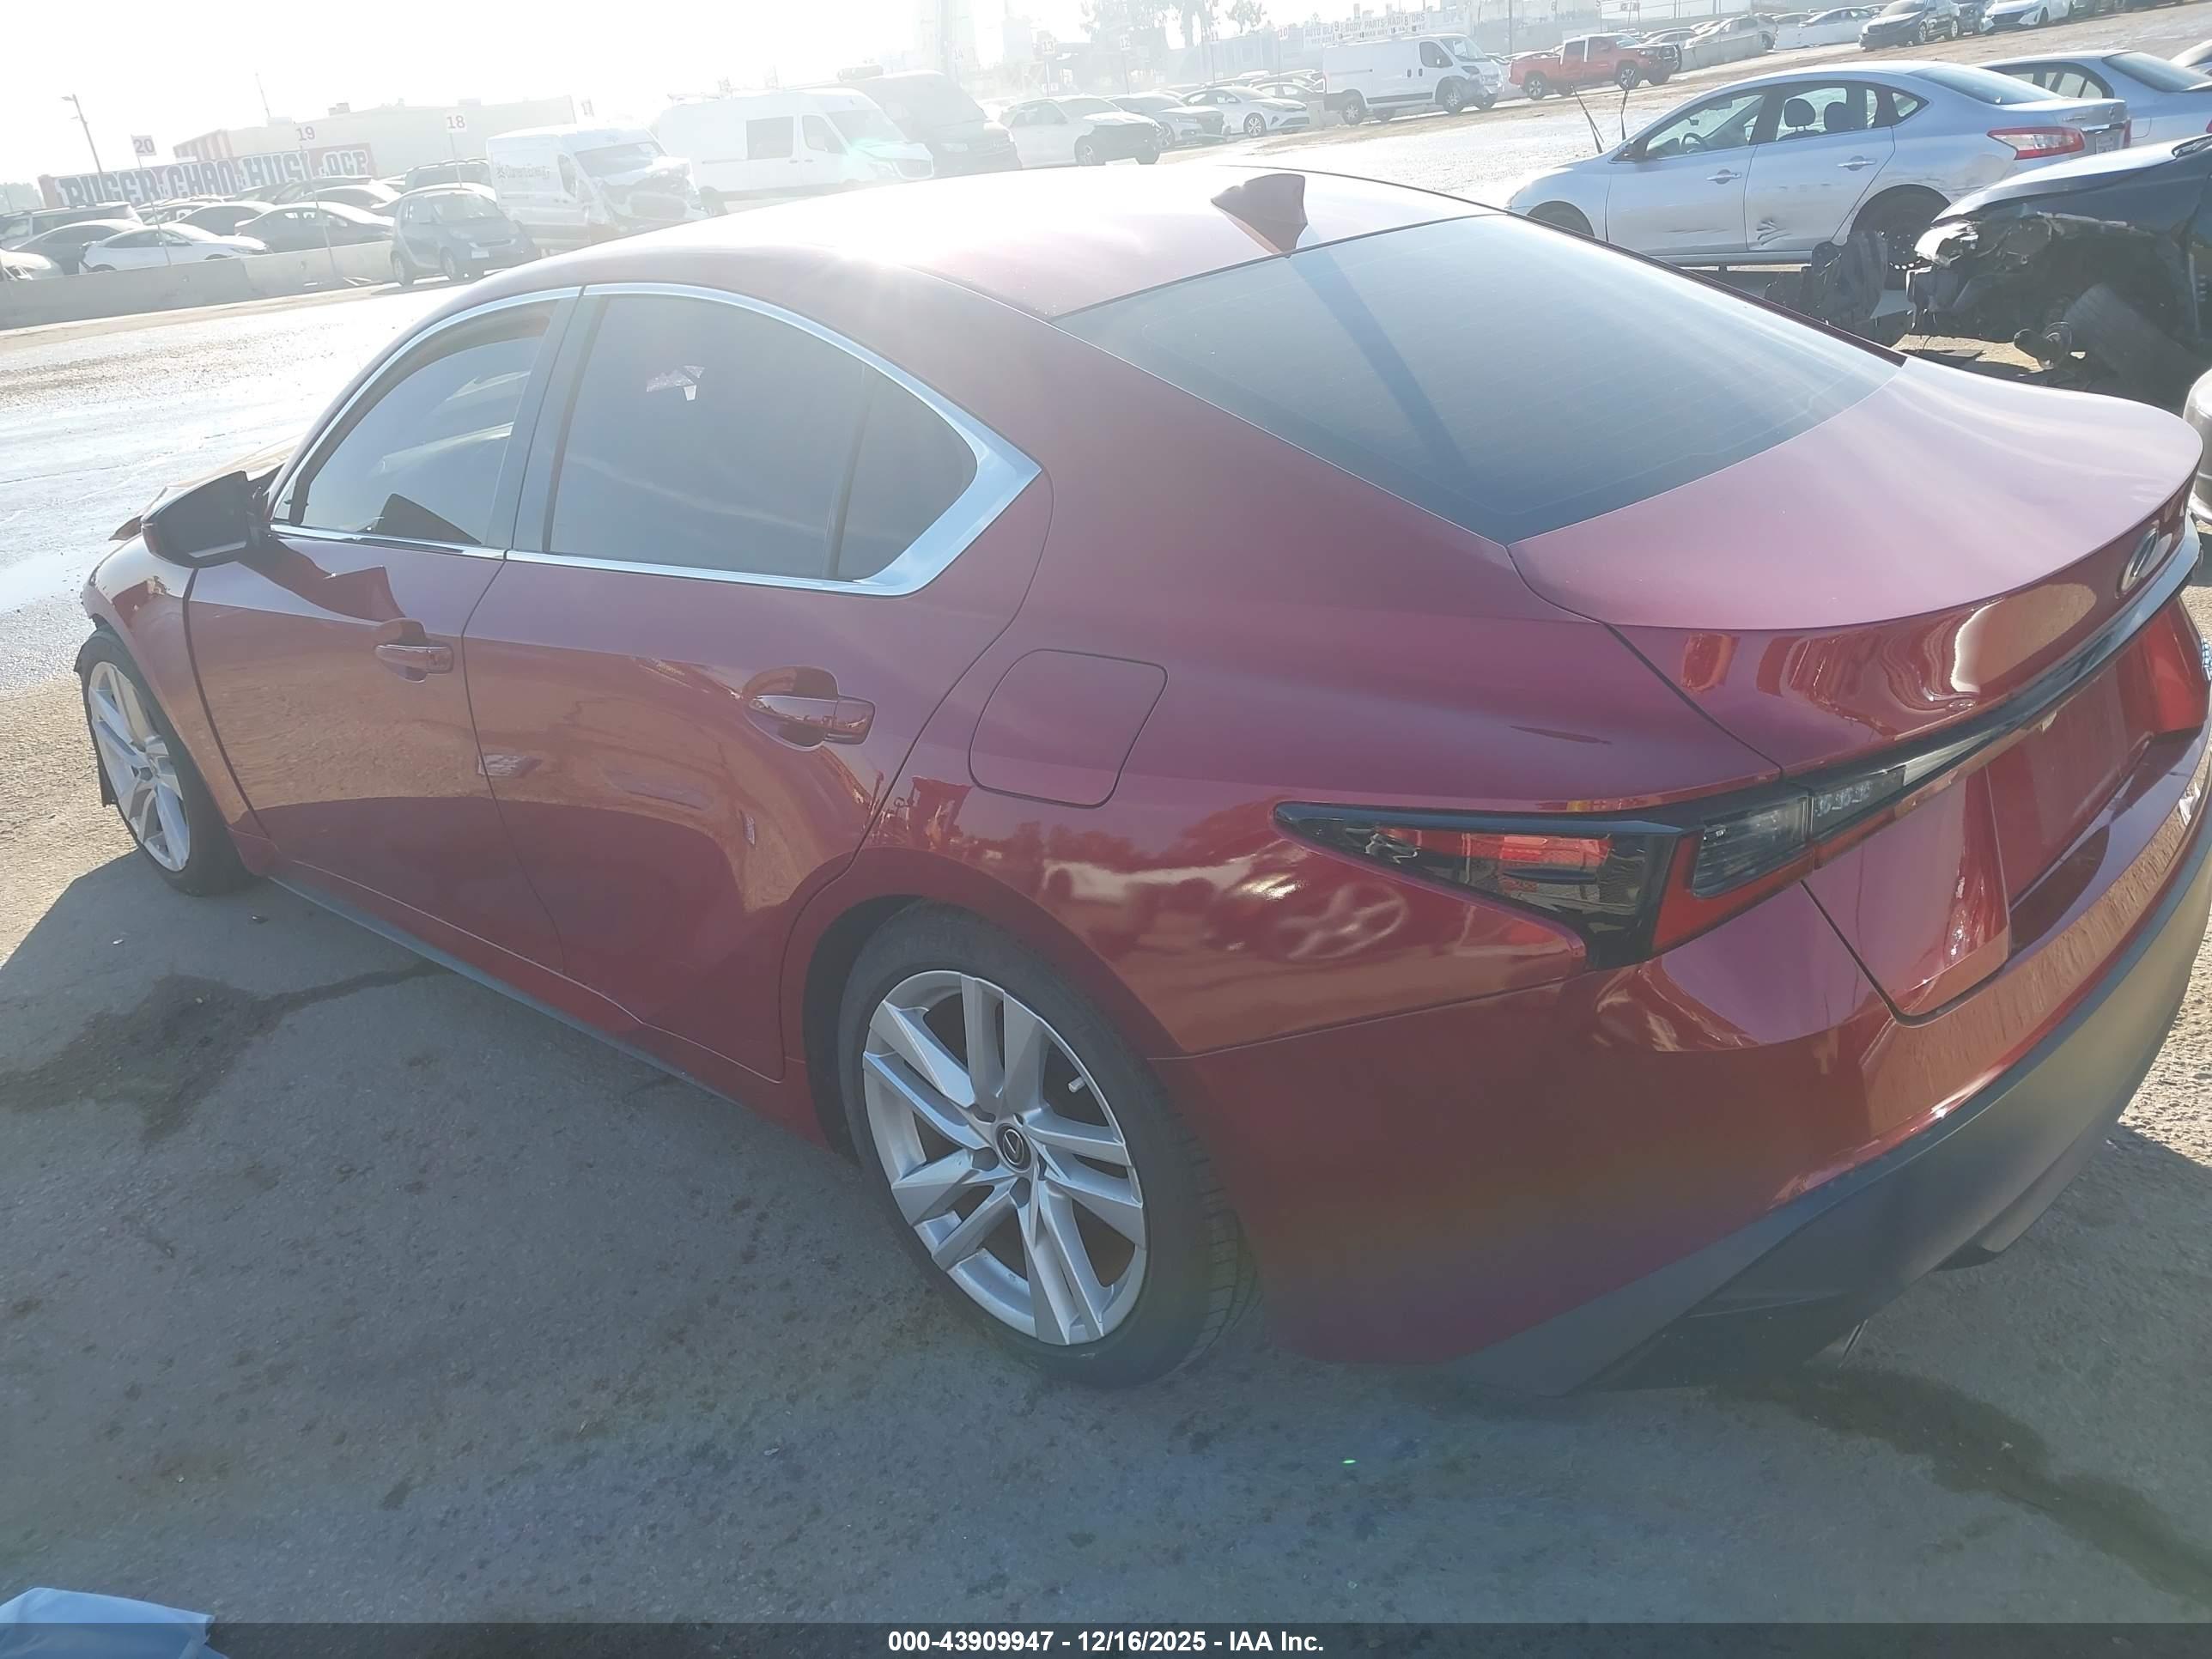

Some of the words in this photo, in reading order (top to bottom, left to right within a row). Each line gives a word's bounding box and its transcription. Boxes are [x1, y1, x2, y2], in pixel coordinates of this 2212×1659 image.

[1364, 19, 1384, 29] PARTS
[1279, 27, 1288, 38] 10
[1043, 41, 1054, 52] 13
[446, 115, 466, 129] 18
[295, 125, 316, 142] 19
[133, 138, 155, 154] 20
